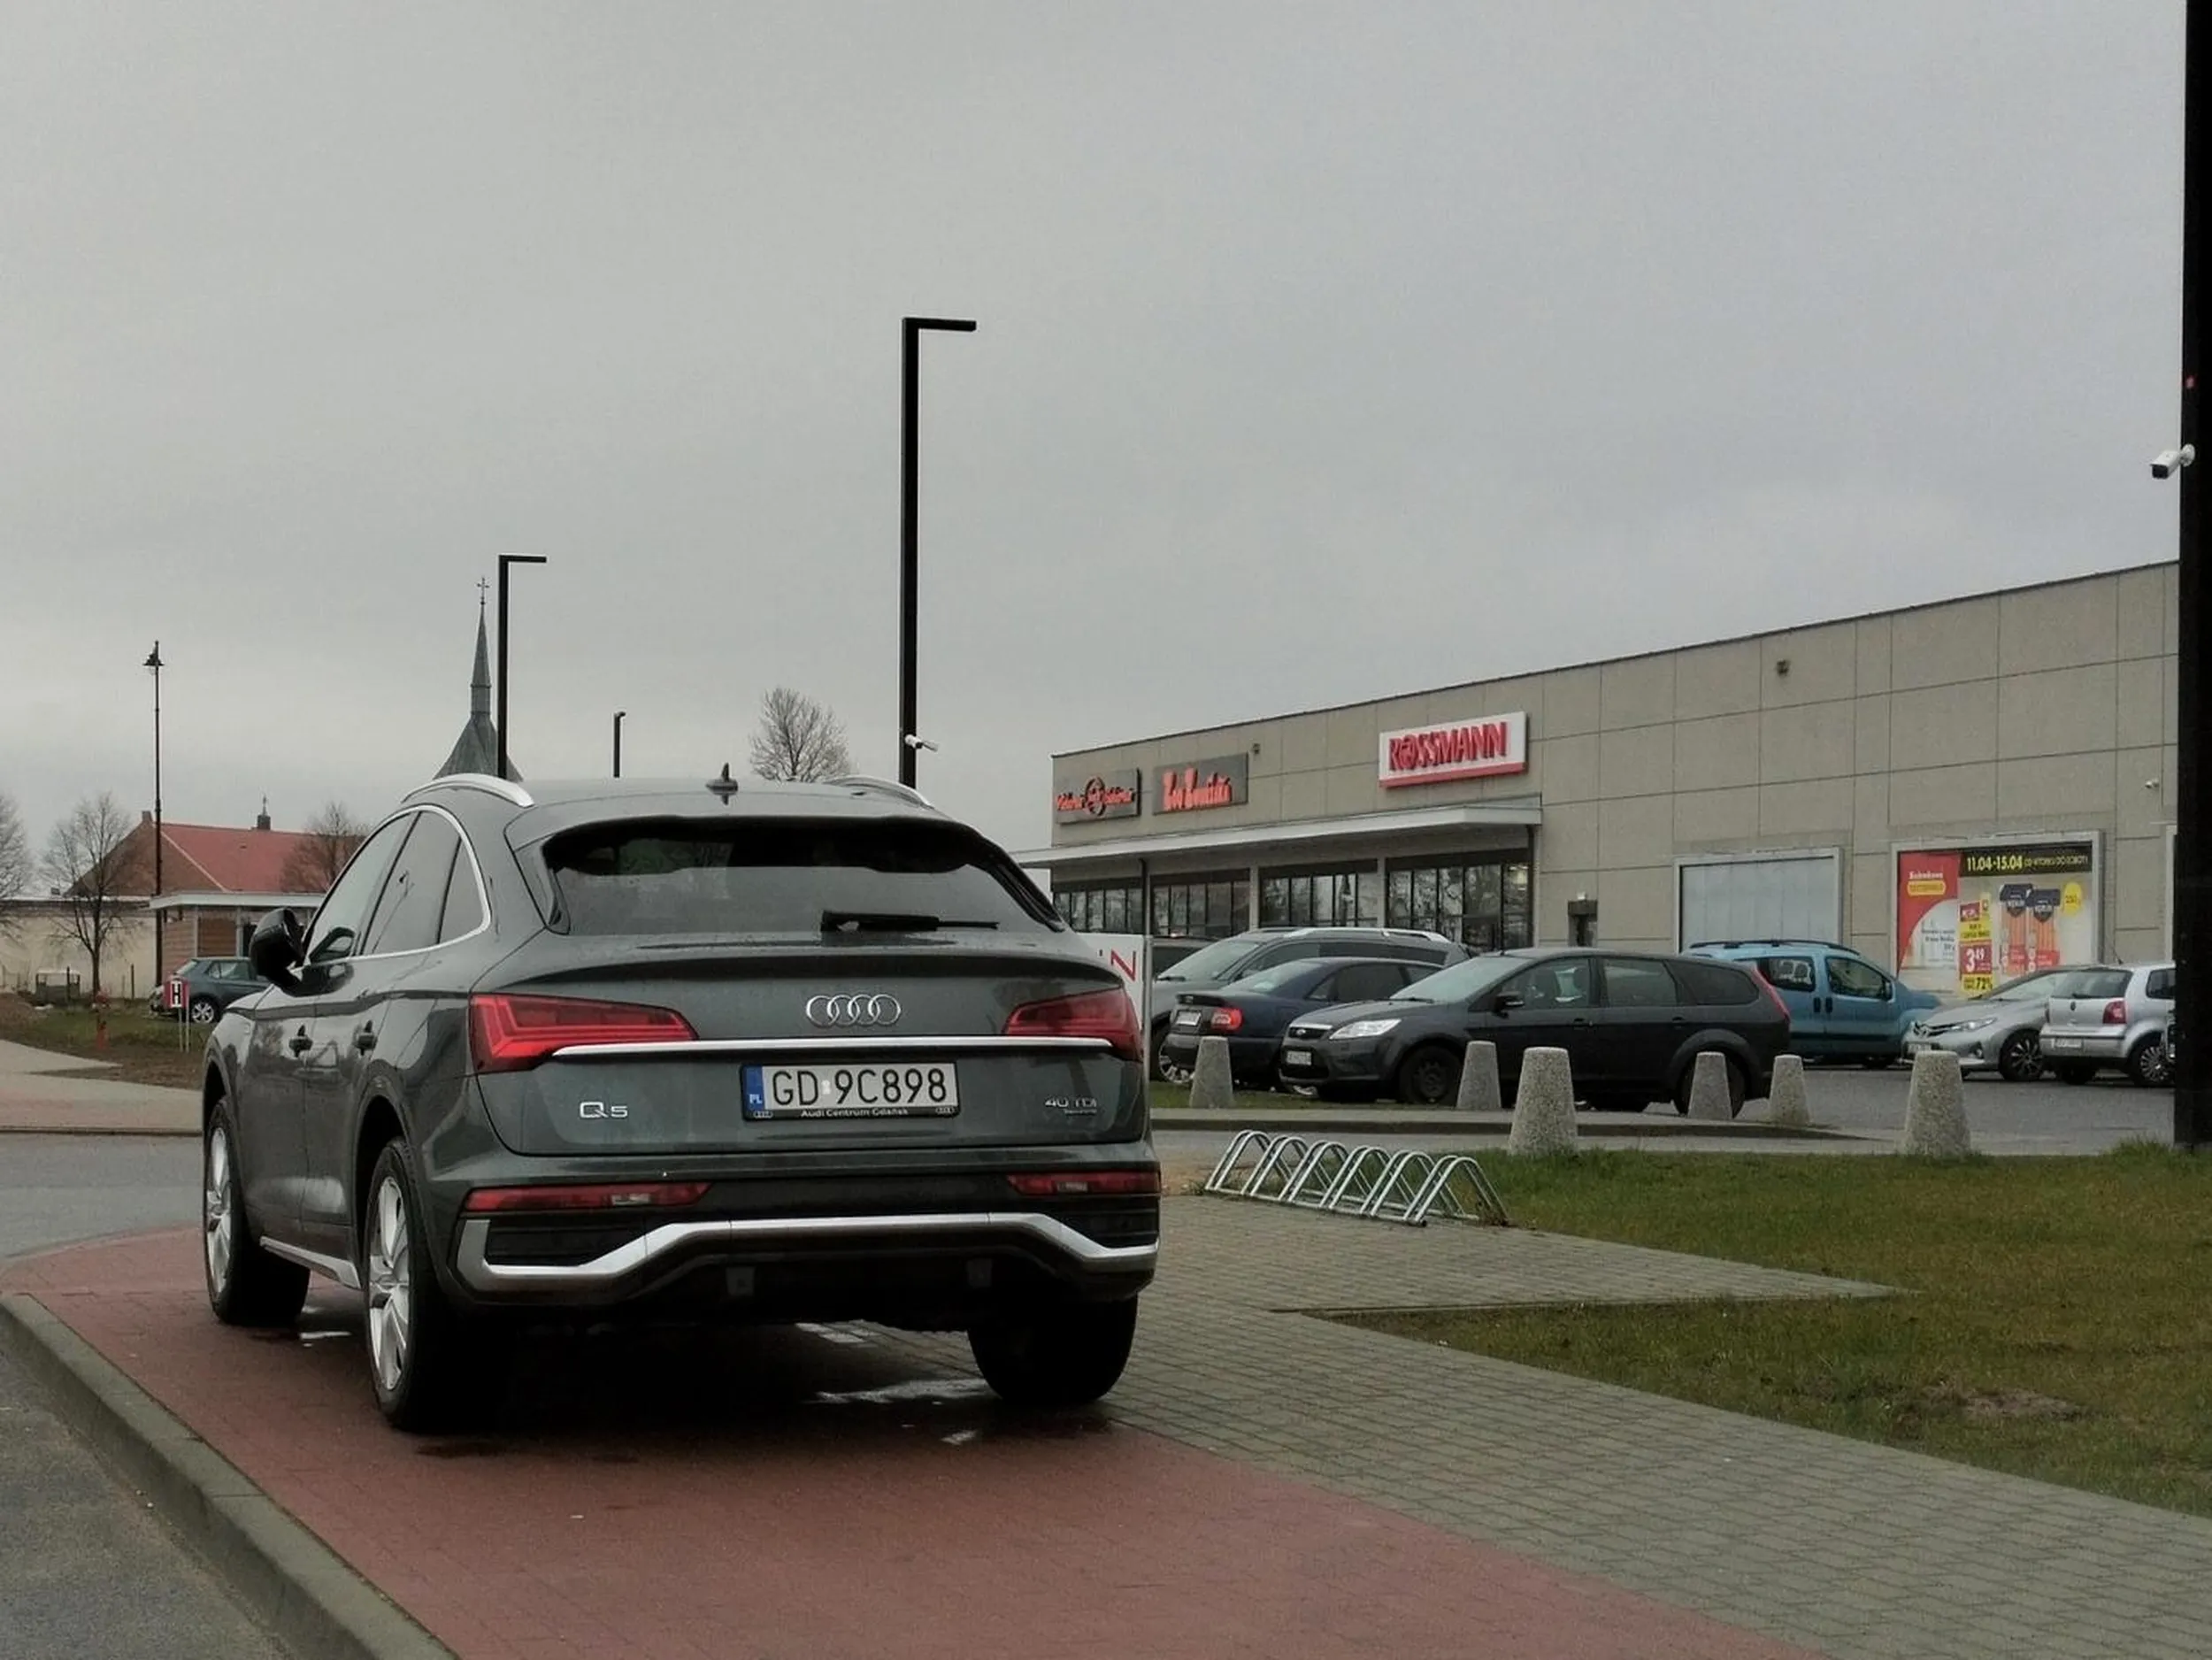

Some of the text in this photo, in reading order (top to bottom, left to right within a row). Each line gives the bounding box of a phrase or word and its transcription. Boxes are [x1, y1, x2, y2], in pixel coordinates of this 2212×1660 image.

[1389, 721, 1508, 771] ROSSMANN
[772, 1067, 947, 1105] GD 9C898
[749, 1094, 763, 1104] PL
[580, 1101, 628, 1118] Q5
[801, 1109, 824, 1118] Audi
[826, 1108, 870, 1118] Centrum
